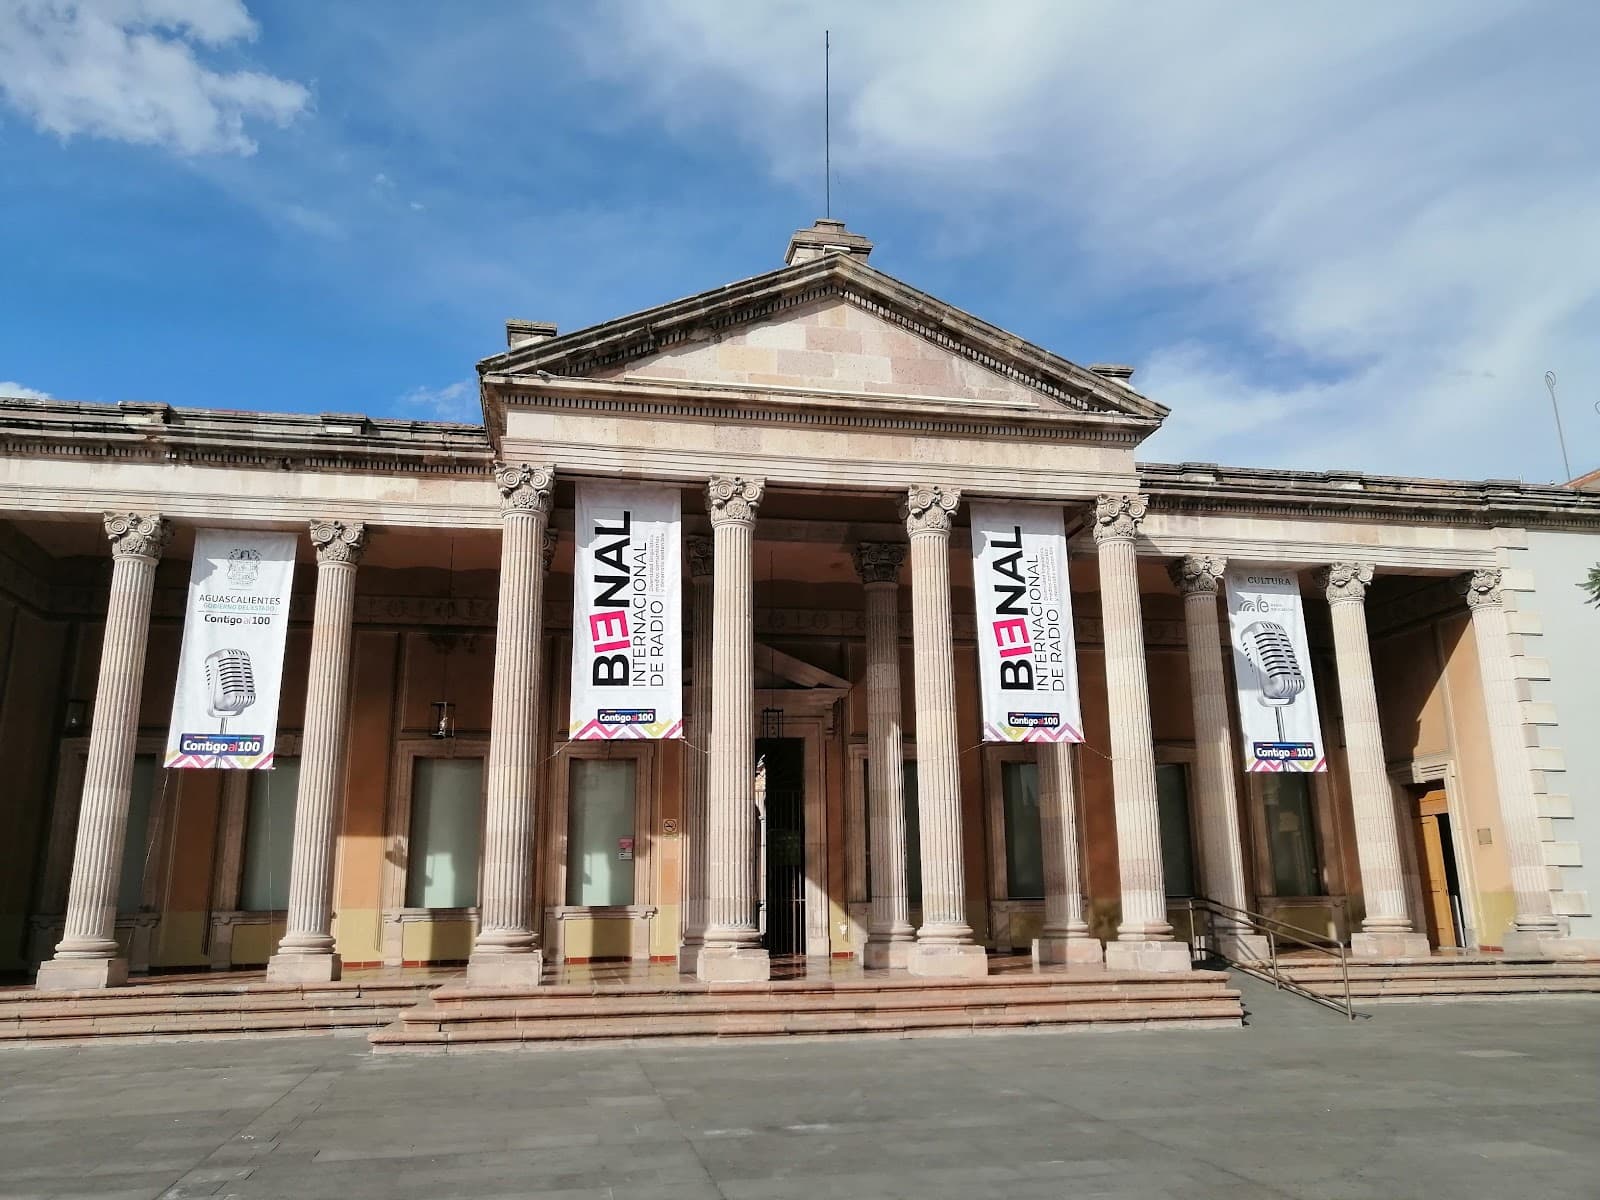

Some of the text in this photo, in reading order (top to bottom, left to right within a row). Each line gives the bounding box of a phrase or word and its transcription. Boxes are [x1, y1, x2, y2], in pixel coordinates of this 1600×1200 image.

[1247, 576, 1291, 585] CULTURA
[199, 594, 280, 605] AGUASCALIENTES
[589, 510, 631, 687] BIENAL
[632, 542, 647, 687] INTERNACIONAL
[990, 525, 1035, 691] BIENAL
[204, 614, 242, 626] Contigo
[252, 616, 271, 625] 100
[1027, 555, 1050, 691] INTERNACIONAL
[650, 600, 664, 687] DE RADIO
[1046, 609, 1063, 662] RADIO
[1051, 668, 1065, 691] DE
[600, 713, 631, 723] Contigo
[638, 713, 654, 721] 100
[1010, 716, 1039, 726] Contigo
[1043, 716, 1058, 725] 100
[183, 740, 260, 754] Contigo al 100
[1256, 747, 1290, 759] Contigo
[1297, 748, 1314, 757] 100
